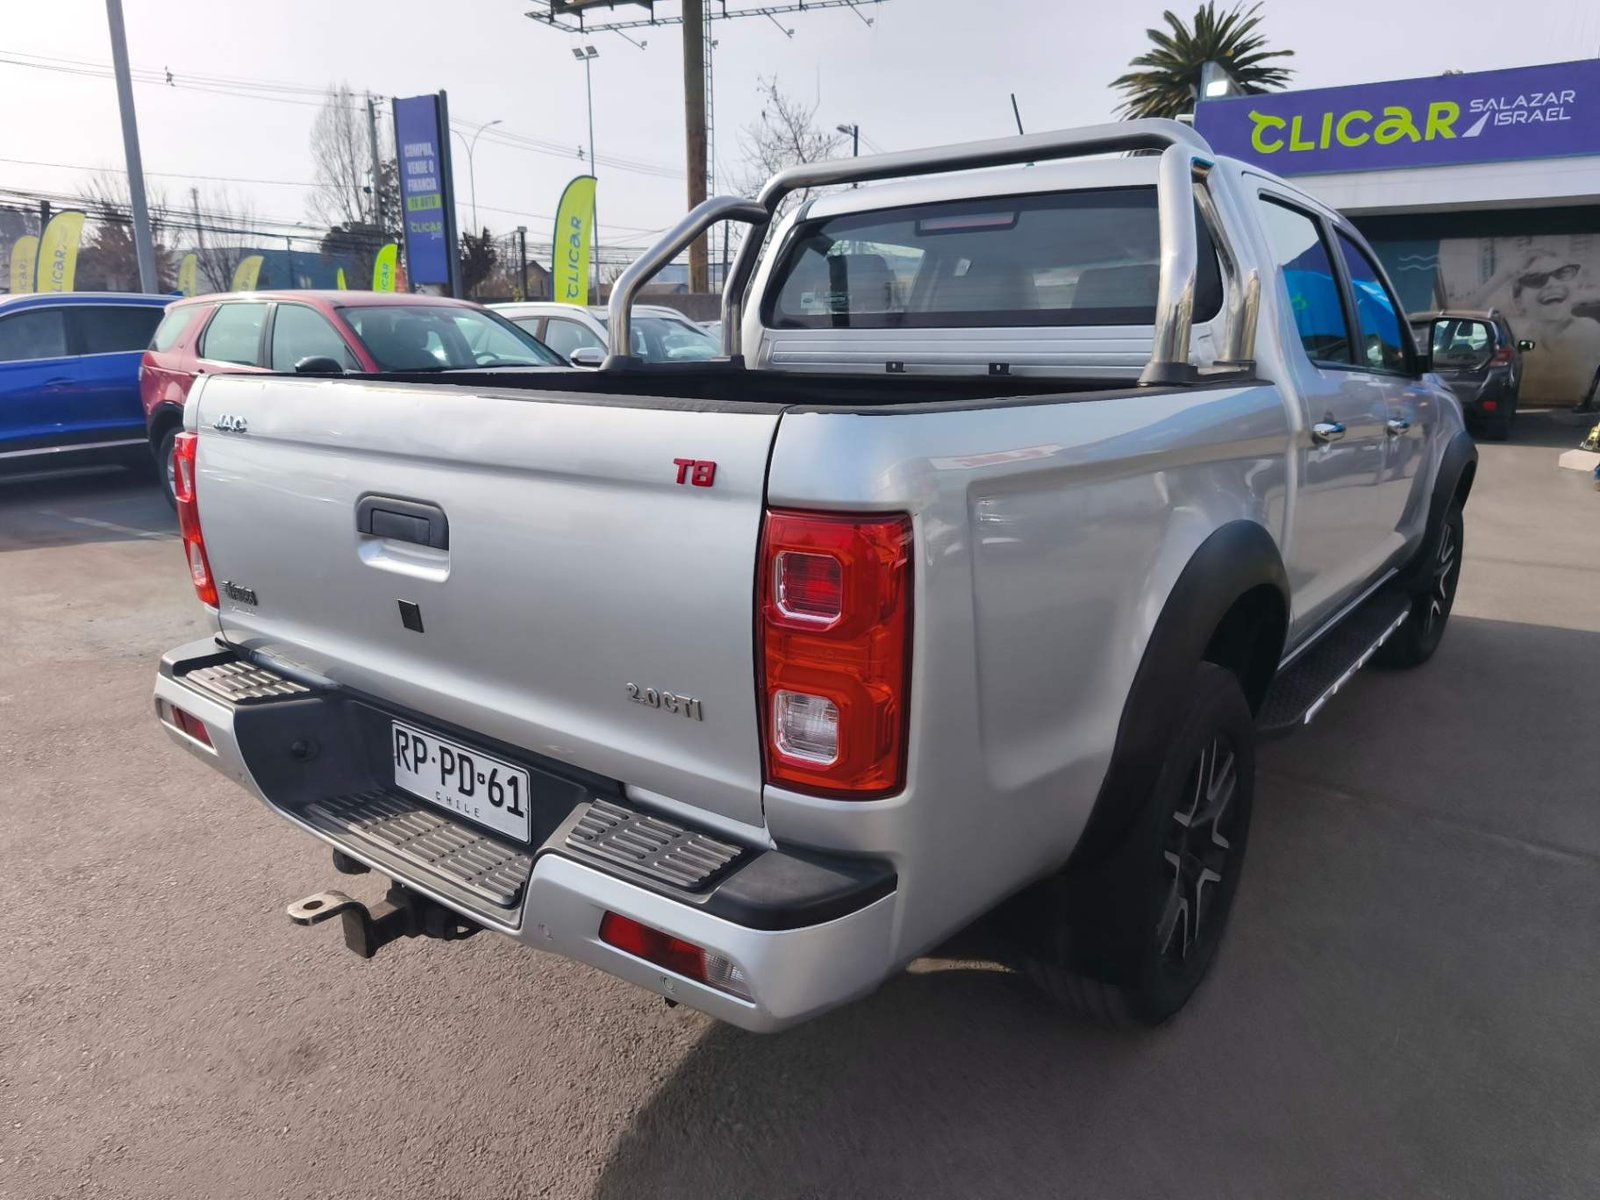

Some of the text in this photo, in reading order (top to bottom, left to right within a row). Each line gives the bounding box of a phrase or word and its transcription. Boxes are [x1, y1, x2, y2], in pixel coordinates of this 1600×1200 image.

[1469, 90, 1576, 113] SALAZAR
[1494, 107, 1572, 127] ISRAEL
[213, 414, 248, 433] JAC
[673, 458, 717, 488] T8
[436, 791, 480, 818] CHILE
